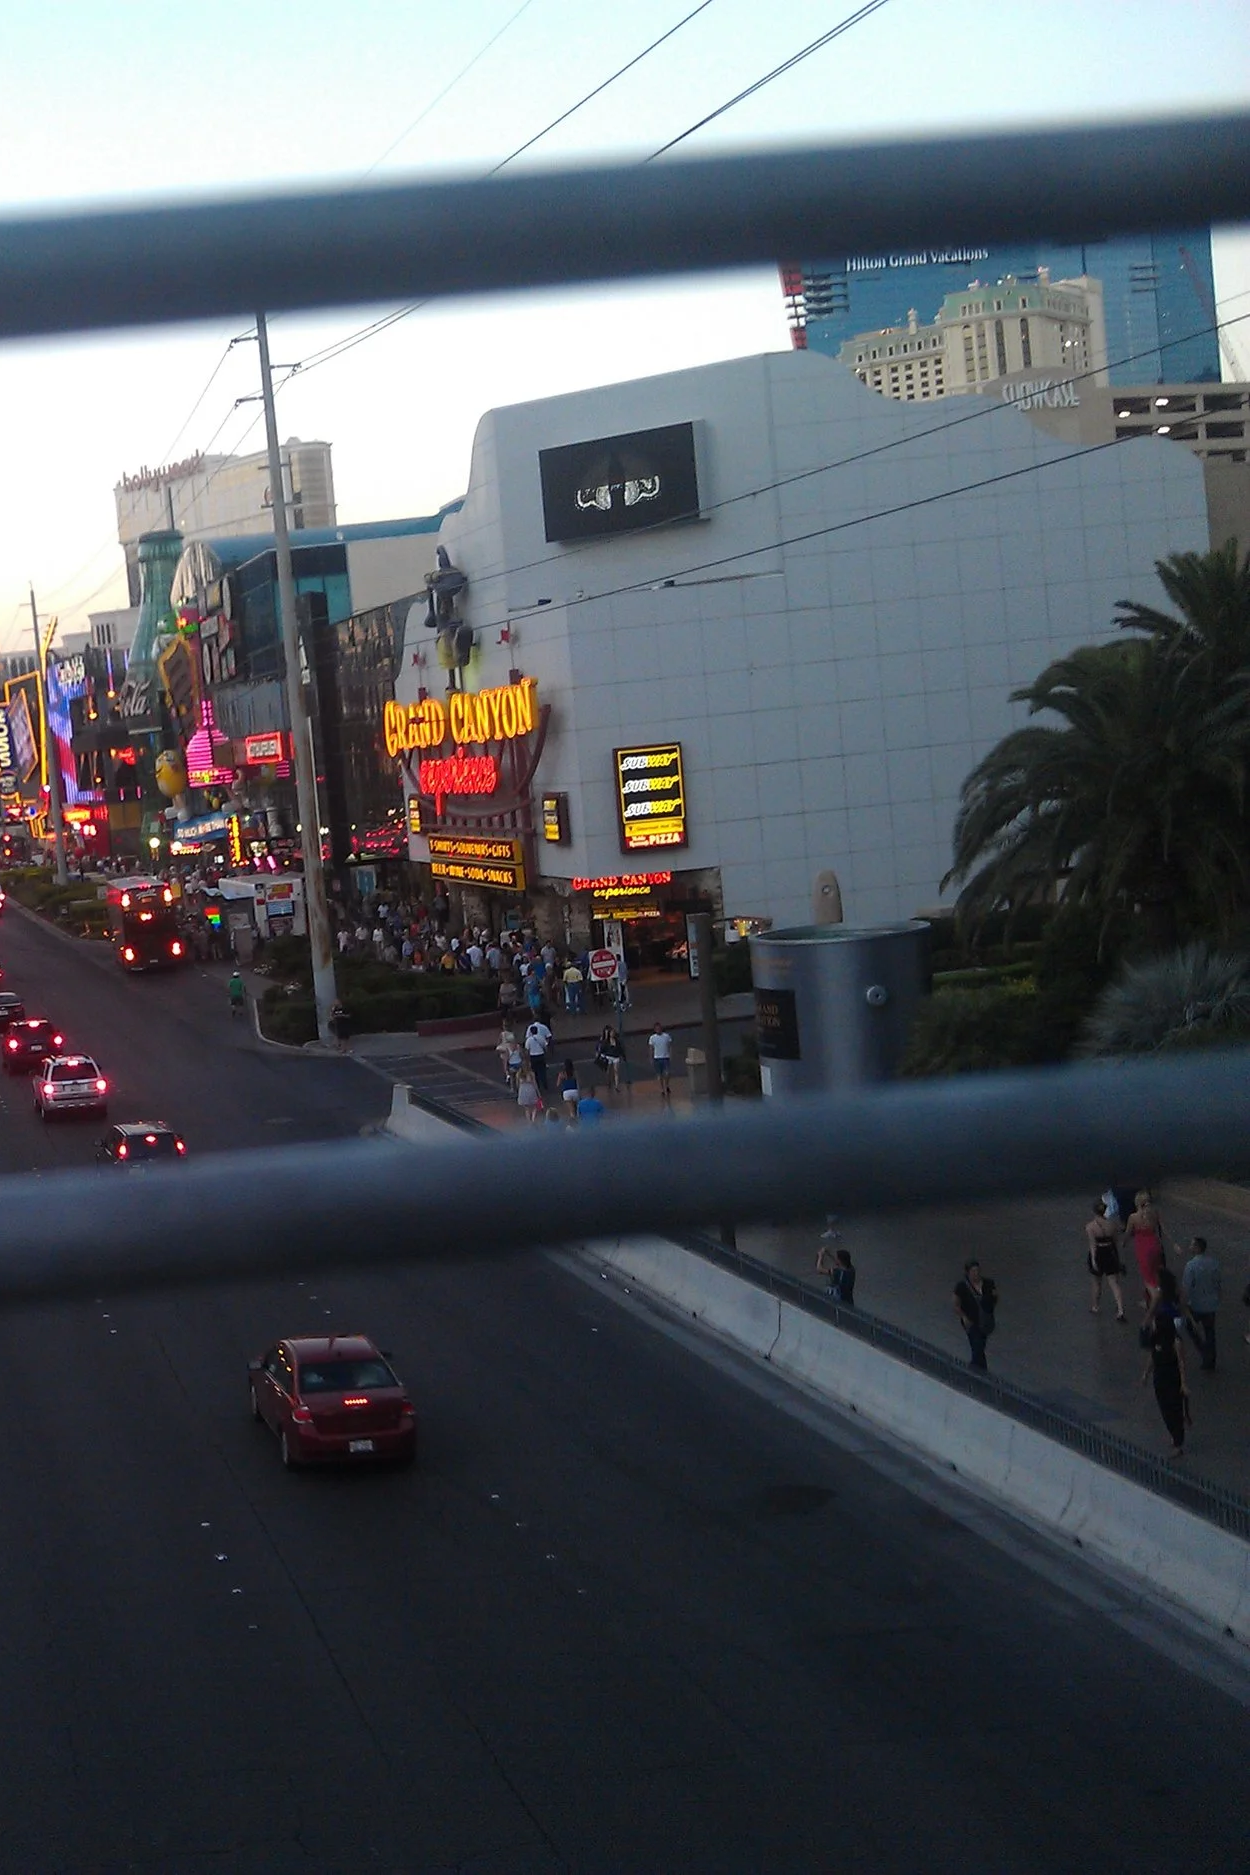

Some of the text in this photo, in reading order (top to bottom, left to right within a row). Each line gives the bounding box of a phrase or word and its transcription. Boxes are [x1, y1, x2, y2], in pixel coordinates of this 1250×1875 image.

[846, 248, 989, 272] Hilton Grand Vacations
[383, 677, 533, 758] GRAND CANYON
[619, 752, 679, 772] SUBWAY
[621, 775, 680, 794] SUBWAY
[623, 798, 682, 818] SUBWAY
[649, 832, 681, 846] PIZZA
[572, 870, 672, 891] GRAND CANYON
[593, 885, 651, 900] experience
